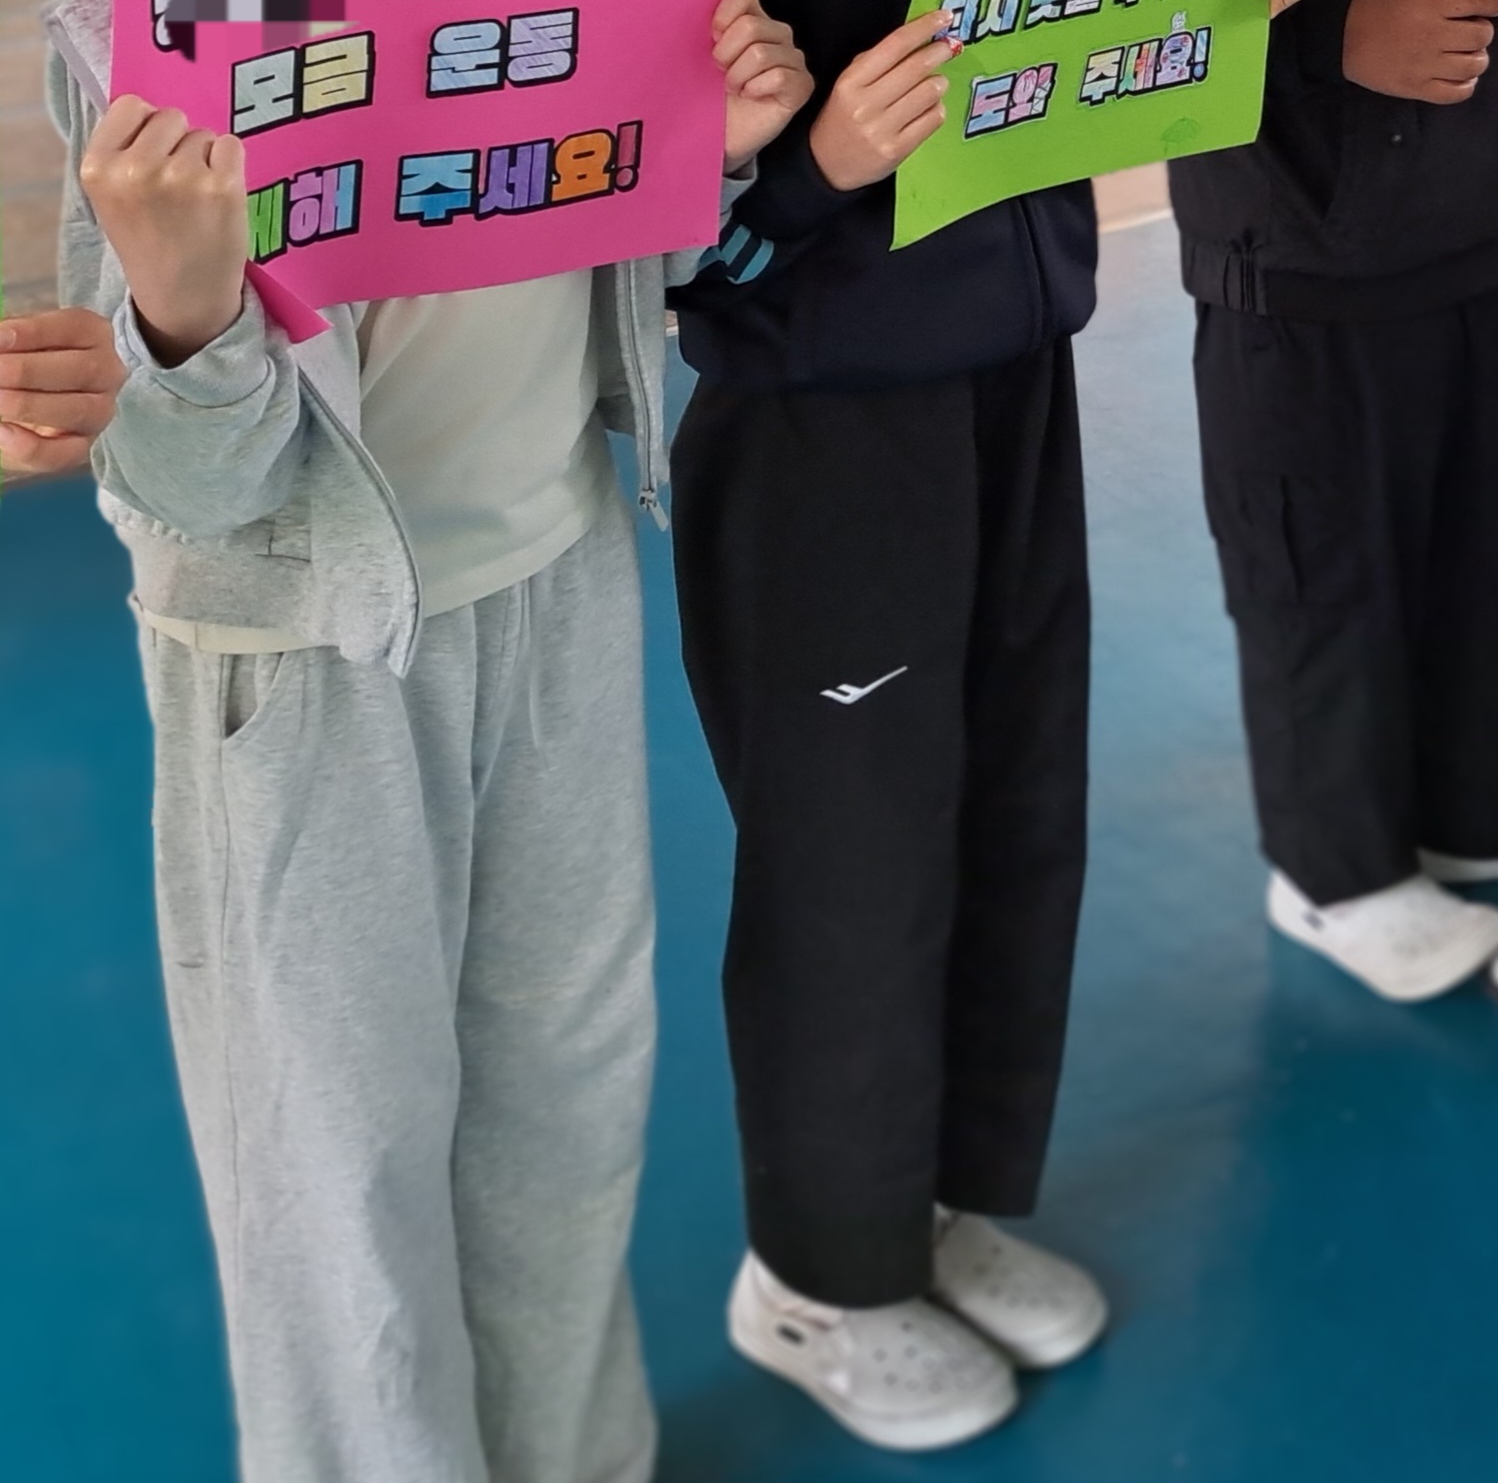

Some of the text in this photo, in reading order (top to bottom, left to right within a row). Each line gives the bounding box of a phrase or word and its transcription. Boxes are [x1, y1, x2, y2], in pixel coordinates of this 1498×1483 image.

[230, 8, 579, 137] 모금 운동
[963, 26, 1213, 139] 도와 주세요!
[395, 120, 643, 226] 주세요!
